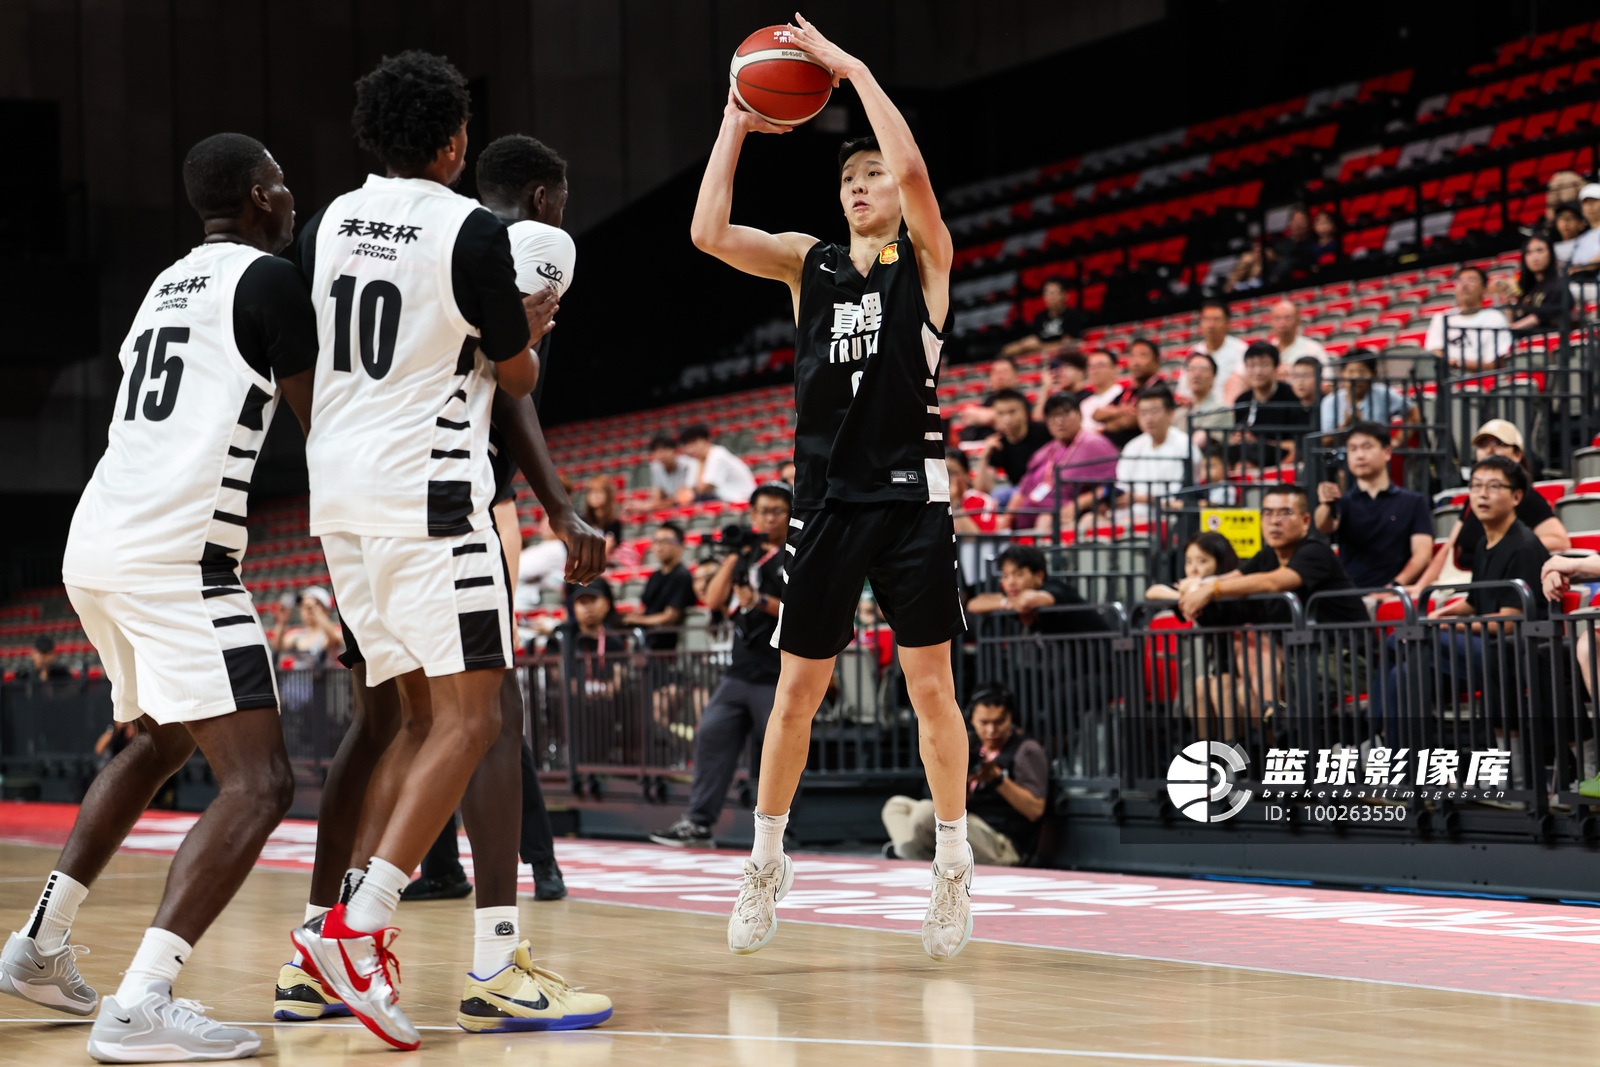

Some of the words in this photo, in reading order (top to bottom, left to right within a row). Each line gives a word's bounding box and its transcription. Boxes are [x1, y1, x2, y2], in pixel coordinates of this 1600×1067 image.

[337, 218, 423, 244] 未来杯
[153, 275, 211, 298] 未来杯
[329, 274, 402, 380] 10
[830, 291, 882, 340] 真理
[124, 326, 190, 422] 15
